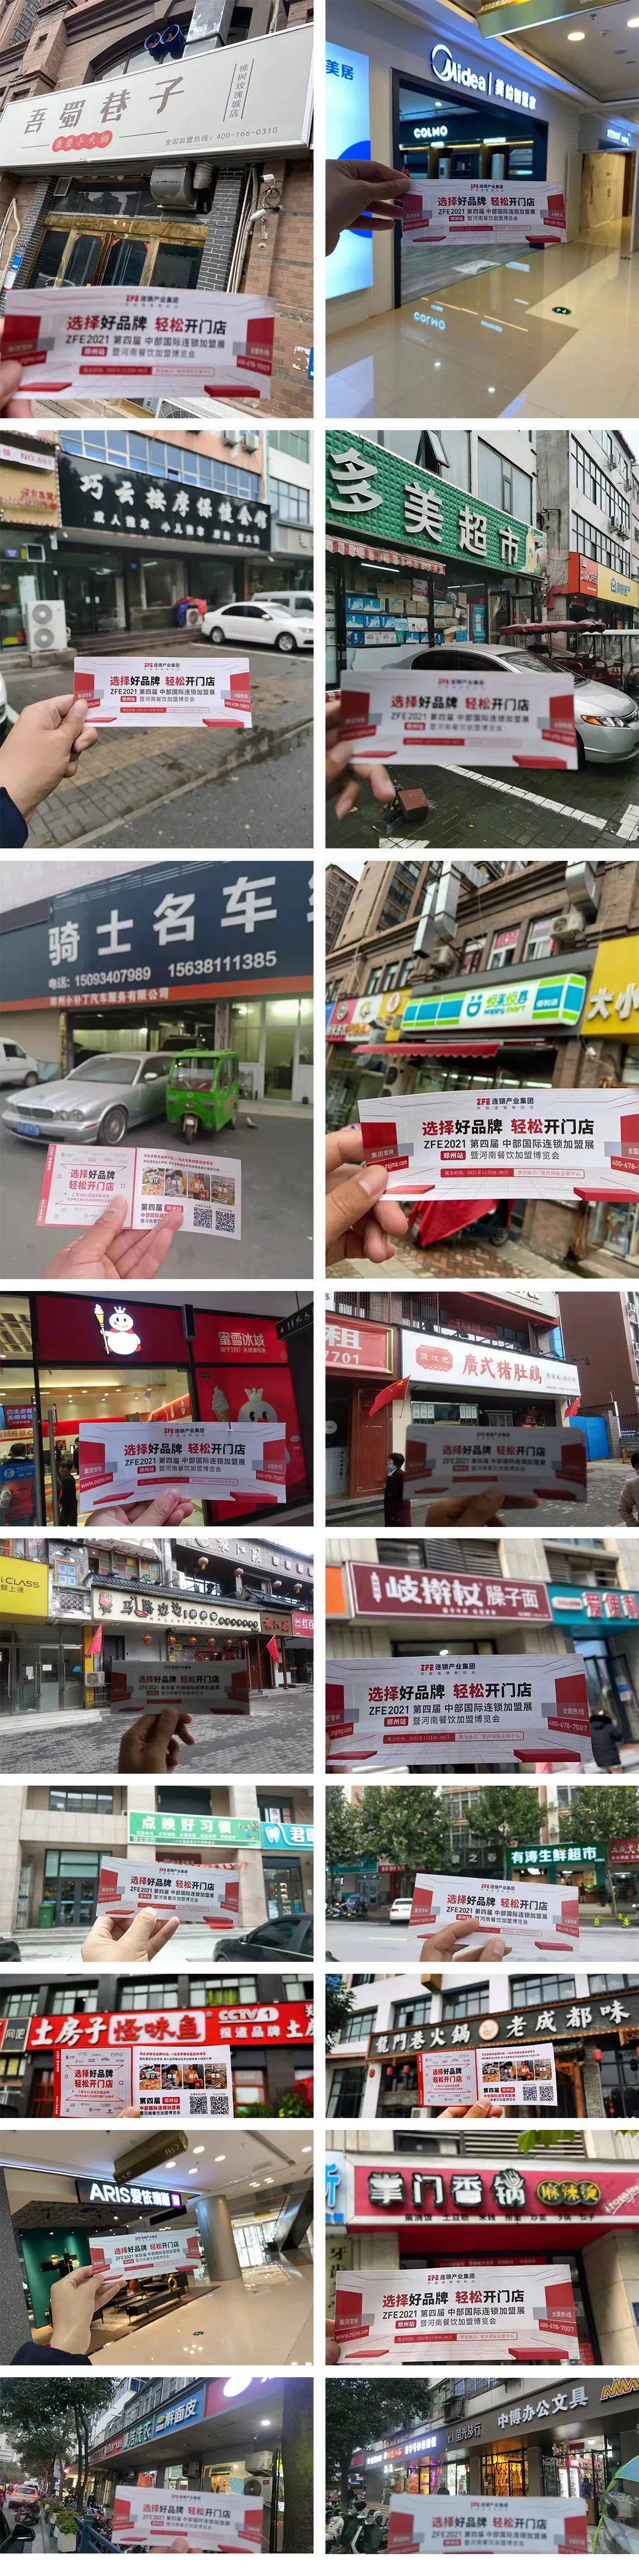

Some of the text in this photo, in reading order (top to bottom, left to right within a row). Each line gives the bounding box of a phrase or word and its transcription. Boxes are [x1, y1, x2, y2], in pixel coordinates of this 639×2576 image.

[325, 59, 353, 80] 美居
[431, 44, 486, 91] Midea
[230, 64, 249, 118] 橡树玫瑰城店
[24, 76, 185, 134] 吾蜀巷子
[216, 127, 278, 140] 400-166-0310
[414, 125, 448, 138] COLMO
[437, 196, 535, 207] 选择好品牌 轻松开门店
[67, 315, 227, 335] 选择好品牌 轻松开门店
[66, 335, 225, 348] ZFE2021 第四届 中部国际连锁加盟展
[329, 447, 521, 566] 多美超市
[109, 676, 215, 686] 选择好品牌 轻松开门店
[391, 695, 530, 711] 选择好品牌 轻松开门店
[48, 876, 314, 967] 骑士名车
[75, 966, 151, 987] 15093407989
[167, 950, 277, 978] 15638111385
[492, 1097, 534, 1105] 连锁产业集团
[422, 1118, 595, 1136] 选择好品牌 轻松开门店
[424, 1139, 595, 1150] ZFE2021 第四届 中部国际连锁加盟展
[470, 1151, 560, 1160] 暨河南餐饮加盟博览会
[70, 1168, 115, 1180] 选择好品牌
[69, 1180, 114, 1192] 轻松开门店
[141, 1203, 163, 1212] 第四届
[218, 1331, 265, 1347] 蜜雪冰城
[124, 1443, 246, 1456] 选择好品牌 轻松开门店
[442, 1445, 546, 1457] 选择好品牌 轻松开门店
[125, 1457, 156, 1466] ZFE2021
[182, 1457, 246, 1465] 中部国际连锁加盟展
[5, 1577, 40, 1588] CLASS
[385, 1574, 484, 1607] 岐擀杖
[121, 1599, 218, 1622] 马路边边 串串香
[435, 1663, 476, 1671] 连锁产业集团
[138, 1675, 220, 1684] 选择好品牌 轻松开门店
[368, 1682, 532, 1702] 选择好品牌 轻松开门店
[369, 1702, 532, 1716] ZFE2021 第四届 中部国际连锁加盟展
[412, 1715, 501, 1725] 暨河南餐饮加盟博览会
[549, 1720, 588, 1732] 400-678-7007
[511, 1847, 597, 1864] 有涛生鲜超市
[130, 1875, 215, 1891] 选择好品牌 轻松开门店
[170, 1890, 214, 1899] 中部国际连锁加盟展
[447, 1894, 548, 1911] 选择好品牌 轻松开门店
[494, 1910, 548, 1920] 中部国际连锁加盟展
[506, 2000, 631, 2038] 老成都味
[31, 2015, 202, 2046] 土房子 怪味鱼
[219, 2026, 280, 2040] 报道品牌
[75, 2069, 114, 2078] 选择好品牌
[75, 2080, 113, 2088] 轻松开门店
[368, 2168, 527, 2207] 掌门香锅
[540, 2181, 599, 2201] 麻辣烫
[89, 2183, 170, 2207] ARIS 爱依瑞斯
[114, 2241, 179, 2255] 选择好品牌 轻松开门店
[382, 2289, 524, 2308] 选择好品牌 轻松开门店
[382, 2306, 525, 2319] ZFE2021 第四届 中部国际连锁加盟展
[420, 2317, 496, 2327] 暨河南餐饮加盟博览会
[540, 2322, 575, 2332] 400-678-7007
[498, 2386, 589, 2429] 中博办公文具
[143, 2503, 231, 2519] 选择好品牌 轻松开门店
[431, 2516, 547, 2530] 选择好品牌 轻松开门店
